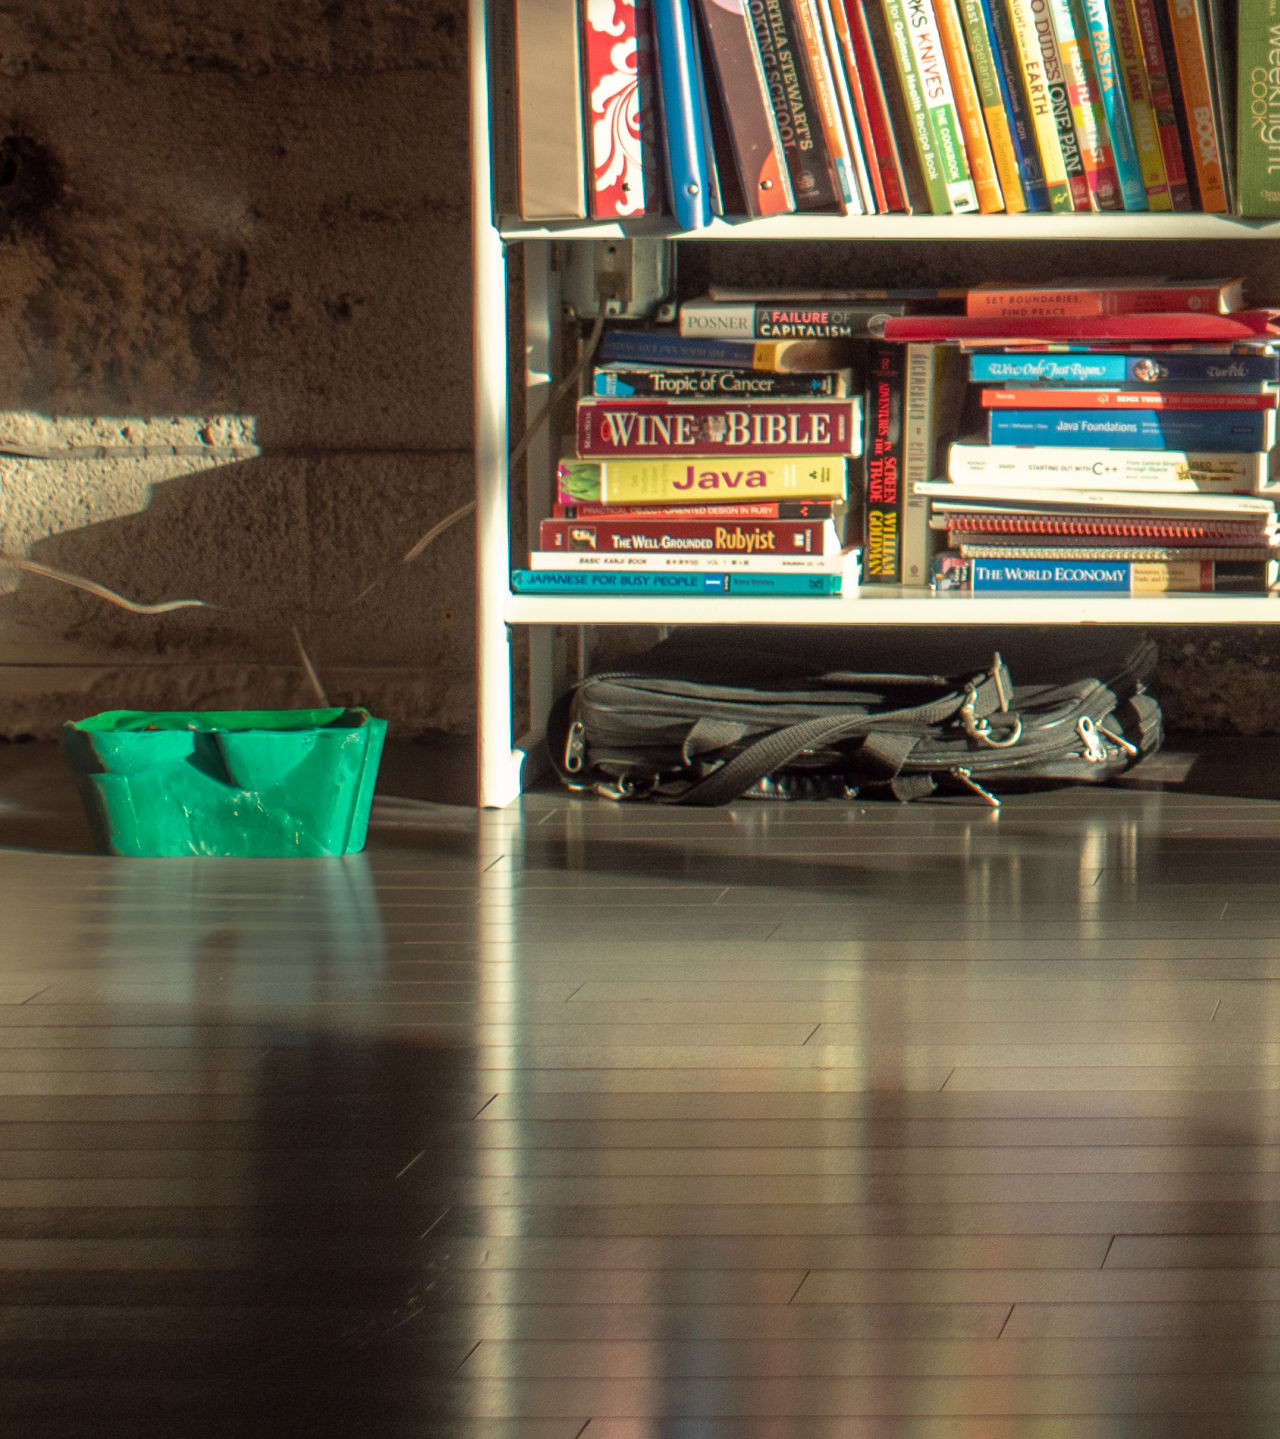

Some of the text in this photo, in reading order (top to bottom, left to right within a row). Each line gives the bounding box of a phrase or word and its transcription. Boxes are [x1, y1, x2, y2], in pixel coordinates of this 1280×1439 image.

[1034, 18, 1061, 81] DUDES
[1090, 28, 1115, 92] PASTA
[917, 33, 944, 100] KNIVES
[1025, 61, 1049, 116] EARTH
[1250, 67, 1268, 128] COOK
[1049, 85, 1072, 129] ONE
[1194, 107, 1219, 168] BOOK
[1060, 131, 1083, 173] PAN
[985, 294, 1079, 305] SET BOUNDARIES
[1001, 307, 1066, 317] FIND PEACE
[688, 315, 749, 330] POSNER
[760, 324, 853, 338] CAPITALISM
[772, 311, 830, 324] FAILURE
[650, 374, 775, 396] Tropic Cancer
[604, 411, 832, 446] WINE BIBLE
[1056, 419, 1138, 433] Java Foundations
[673, 466, 769, 491] Java
[869, 456, 897, 504] SCREEN TRADE
[1028, 464, 1058, 472] STARTING
[612, 526, 777, 553] THE WELL-GROUNDED Rubyist
[868, 511, 897, 576] WILLIAM GOLDMAN
[529, 573, 699, 587] JAPANESE FOR BUSY PEOPLE
[976, 566, 1127, 582] THE WORLD ECONOMY
